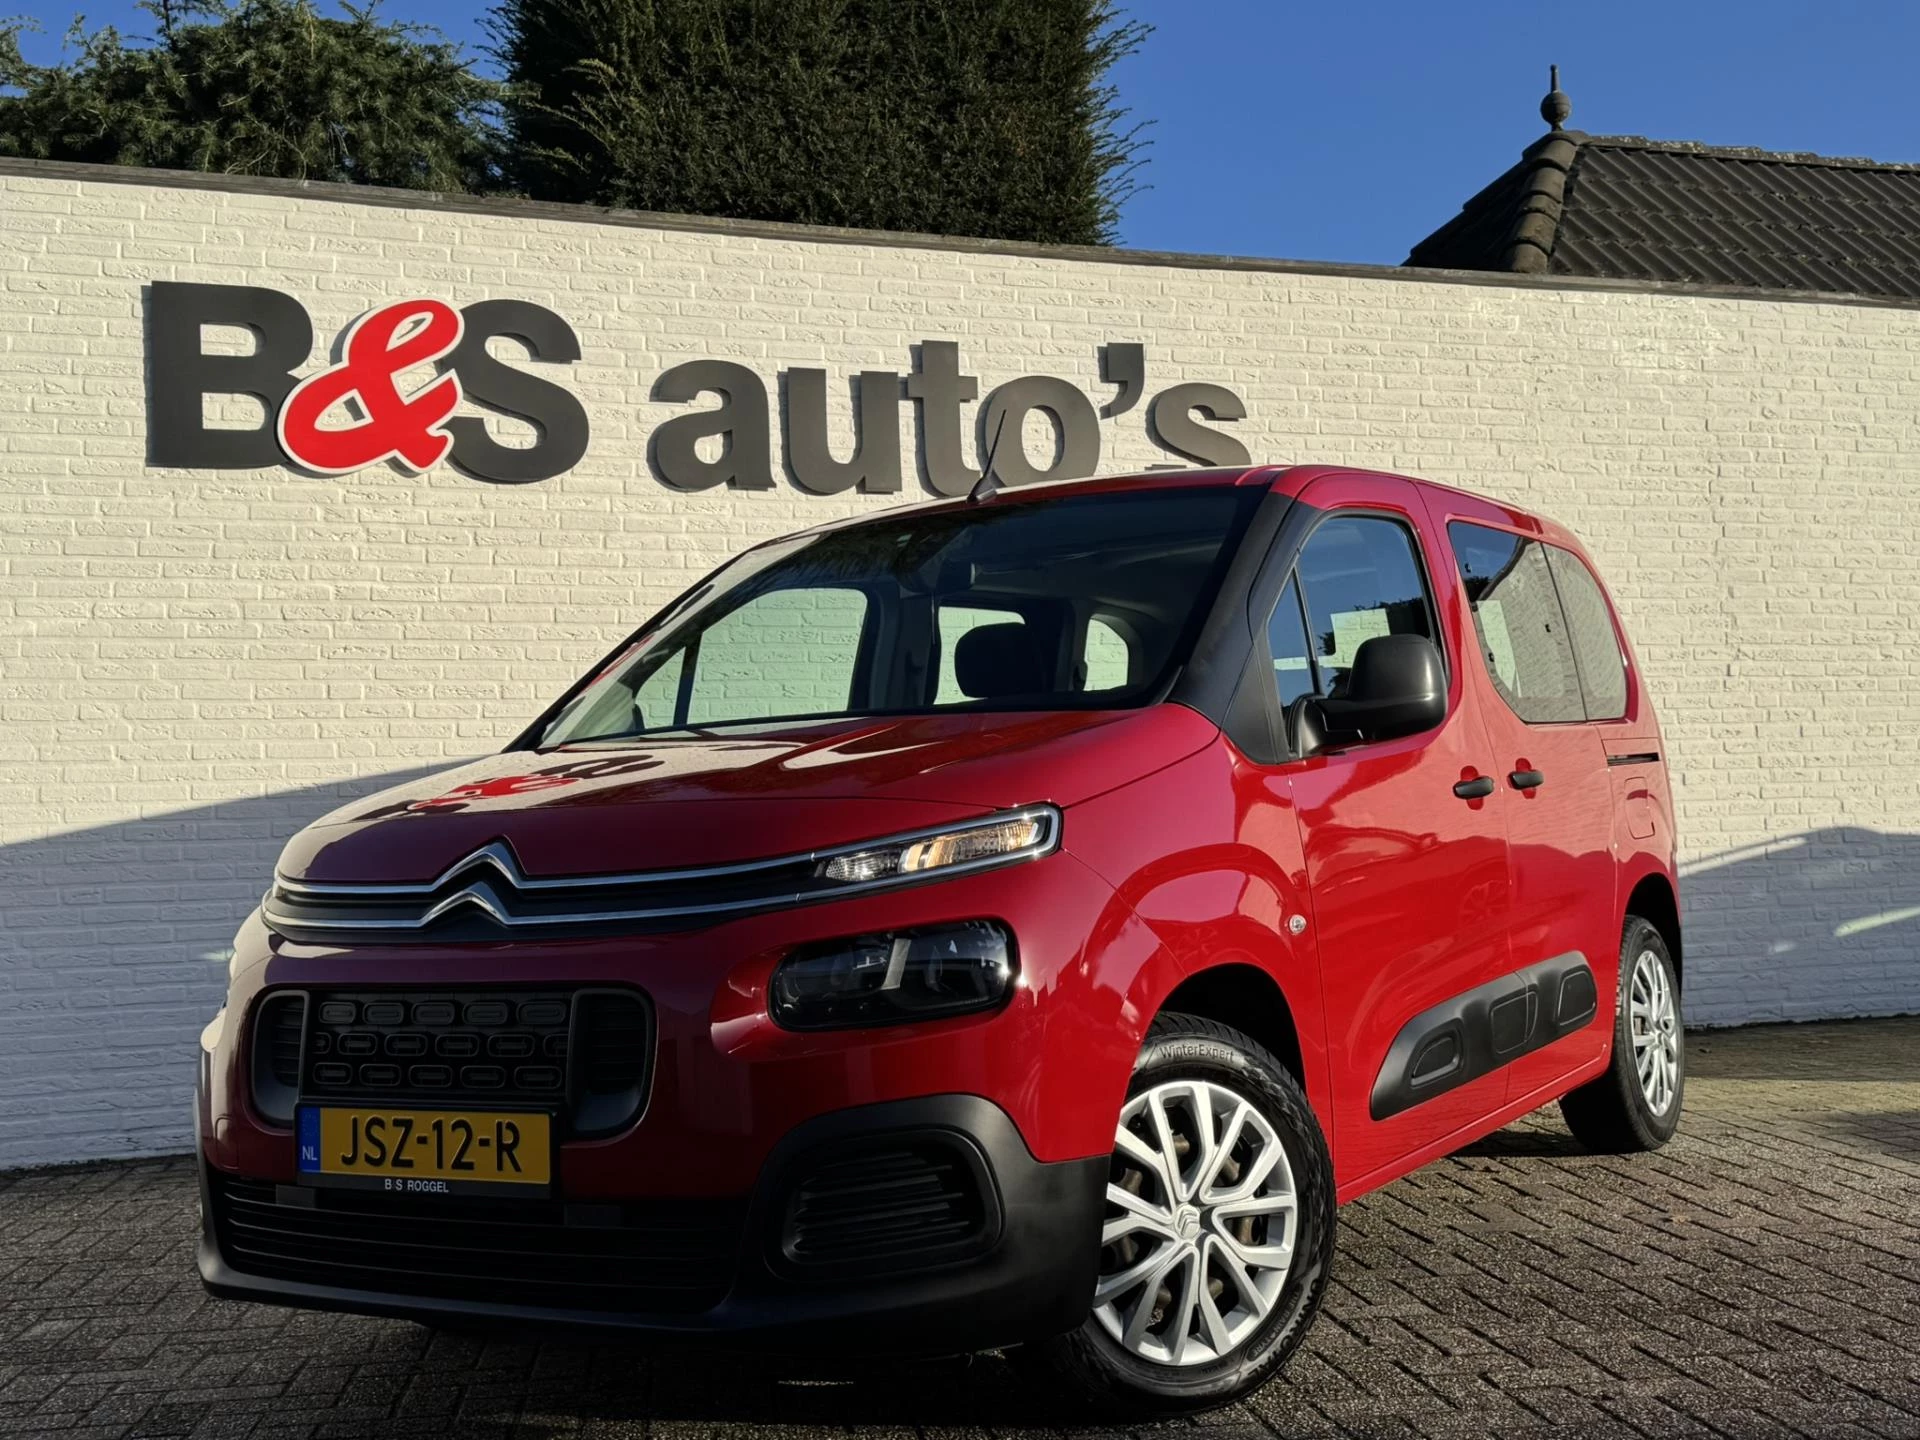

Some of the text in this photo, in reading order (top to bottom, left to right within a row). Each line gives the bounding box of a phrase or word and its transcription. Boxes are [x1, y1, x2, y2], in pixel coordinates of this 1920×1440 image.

[143, 281, 590, 484] B&S
[1160, 1043, 1235, 1062] WinterExpert
[302, 1145, 318, 1161] NL
[340, 1115, 522, 1172] JSZ-12-R
[407, 1179, 450, 1193] ROGGEL
